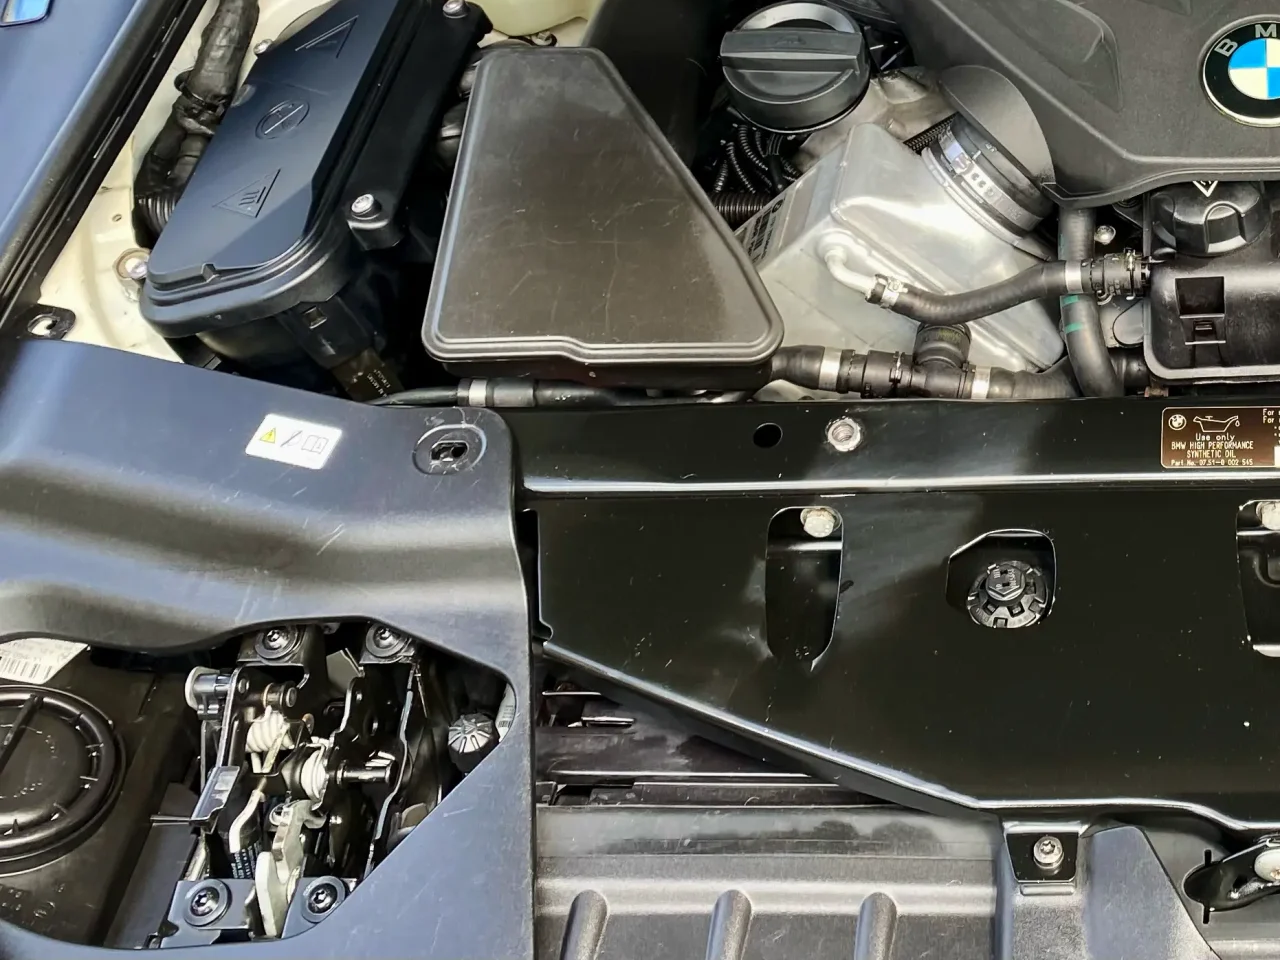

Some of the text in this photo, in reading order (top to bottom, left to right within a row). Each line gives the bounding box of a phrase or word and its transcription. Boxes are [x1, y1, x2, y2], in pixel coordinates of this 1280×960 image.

[1262, 408, 1275, 416] For
[1262, 416, 1275, 424] For
[1195, 432, 1236, 443] Use only
[1171, 440, 1254, 450] BMW HIGH PERFORMANCE
[1186, 449, 1237, 459] SYNTHETIC OIL
